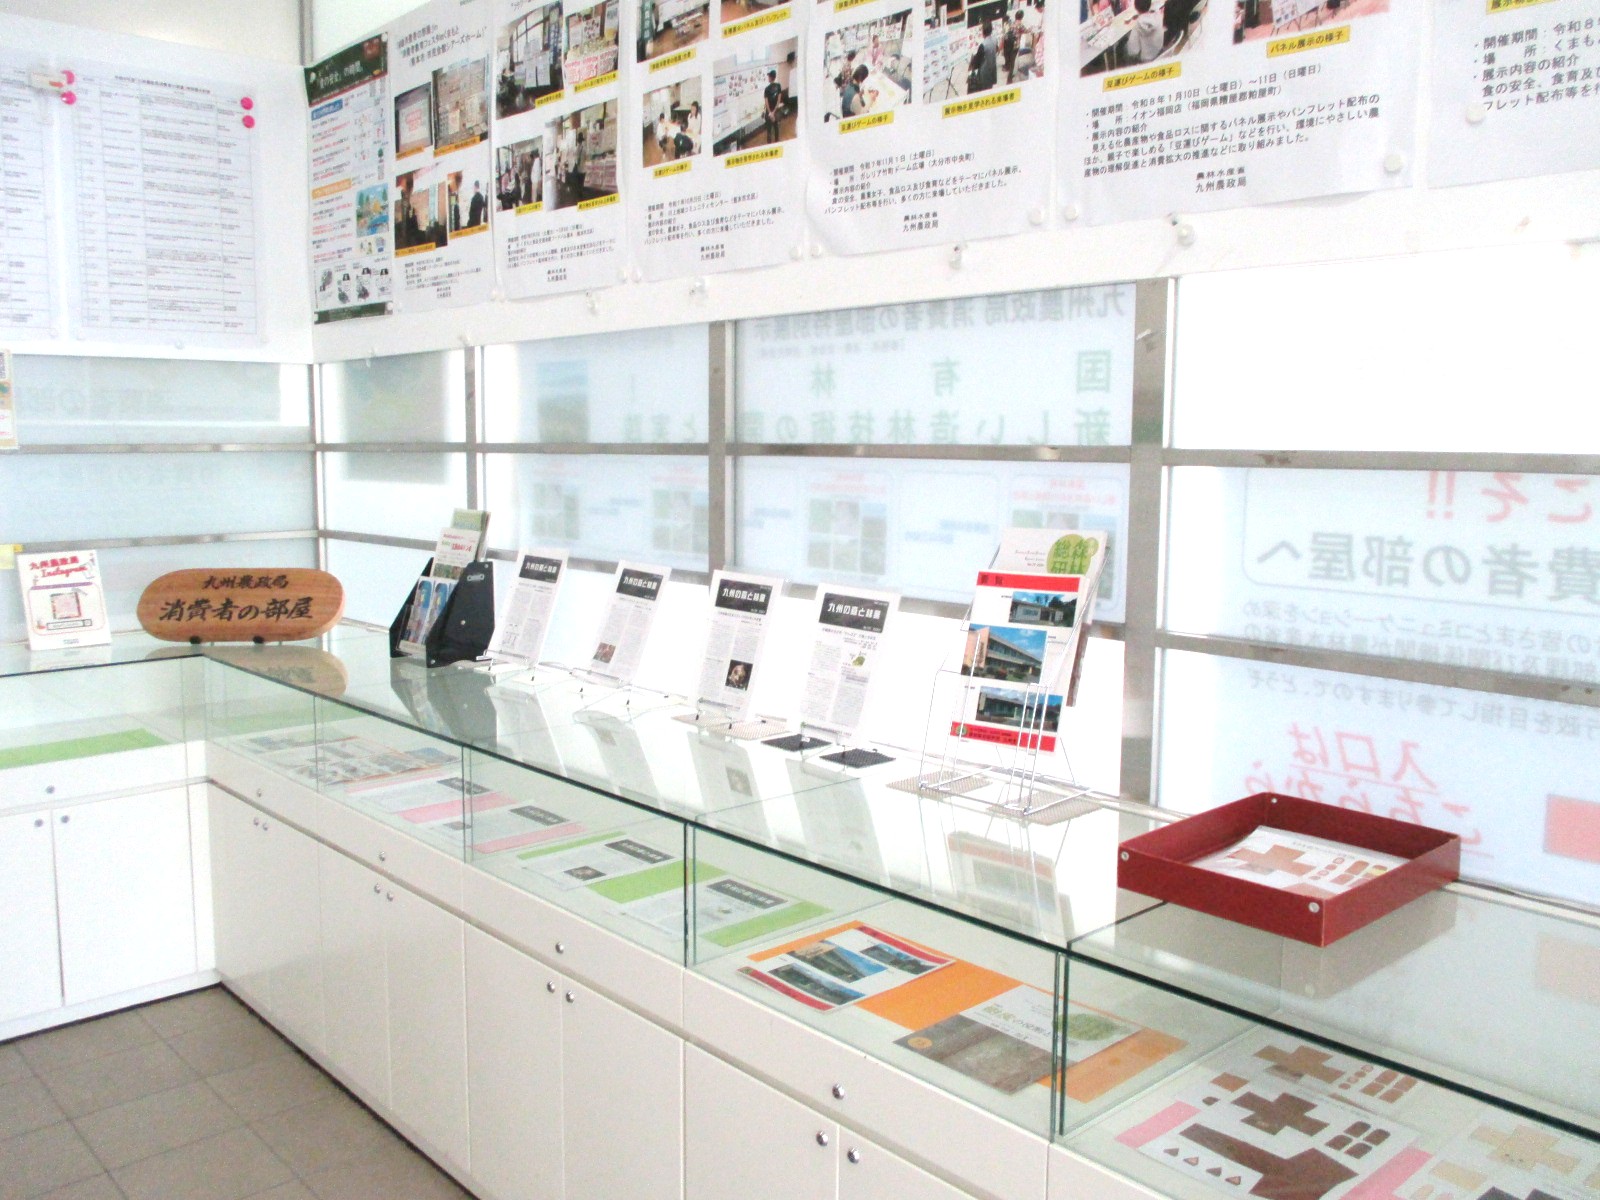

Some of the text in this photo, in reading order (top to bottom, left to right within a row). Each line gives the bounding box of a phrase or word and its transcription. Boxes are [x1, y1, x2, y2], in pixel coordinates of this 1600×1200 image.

[1271, 30, 1344, 54] パネル展示の様子
[1475, 18, 1600, 49] ・開催期間：令和8
[1106, 67, 1174, 89] 豆運びゲームの様子
[1195, 177, 1247, 194] 九州農政局
[903, 220, 939, 233] 九州農政局
[41, 565, 88, 578] Instagram
[202, 574, 289, 590] 九州農政局
[159, 596, 314, 622] 消費者の部屋
